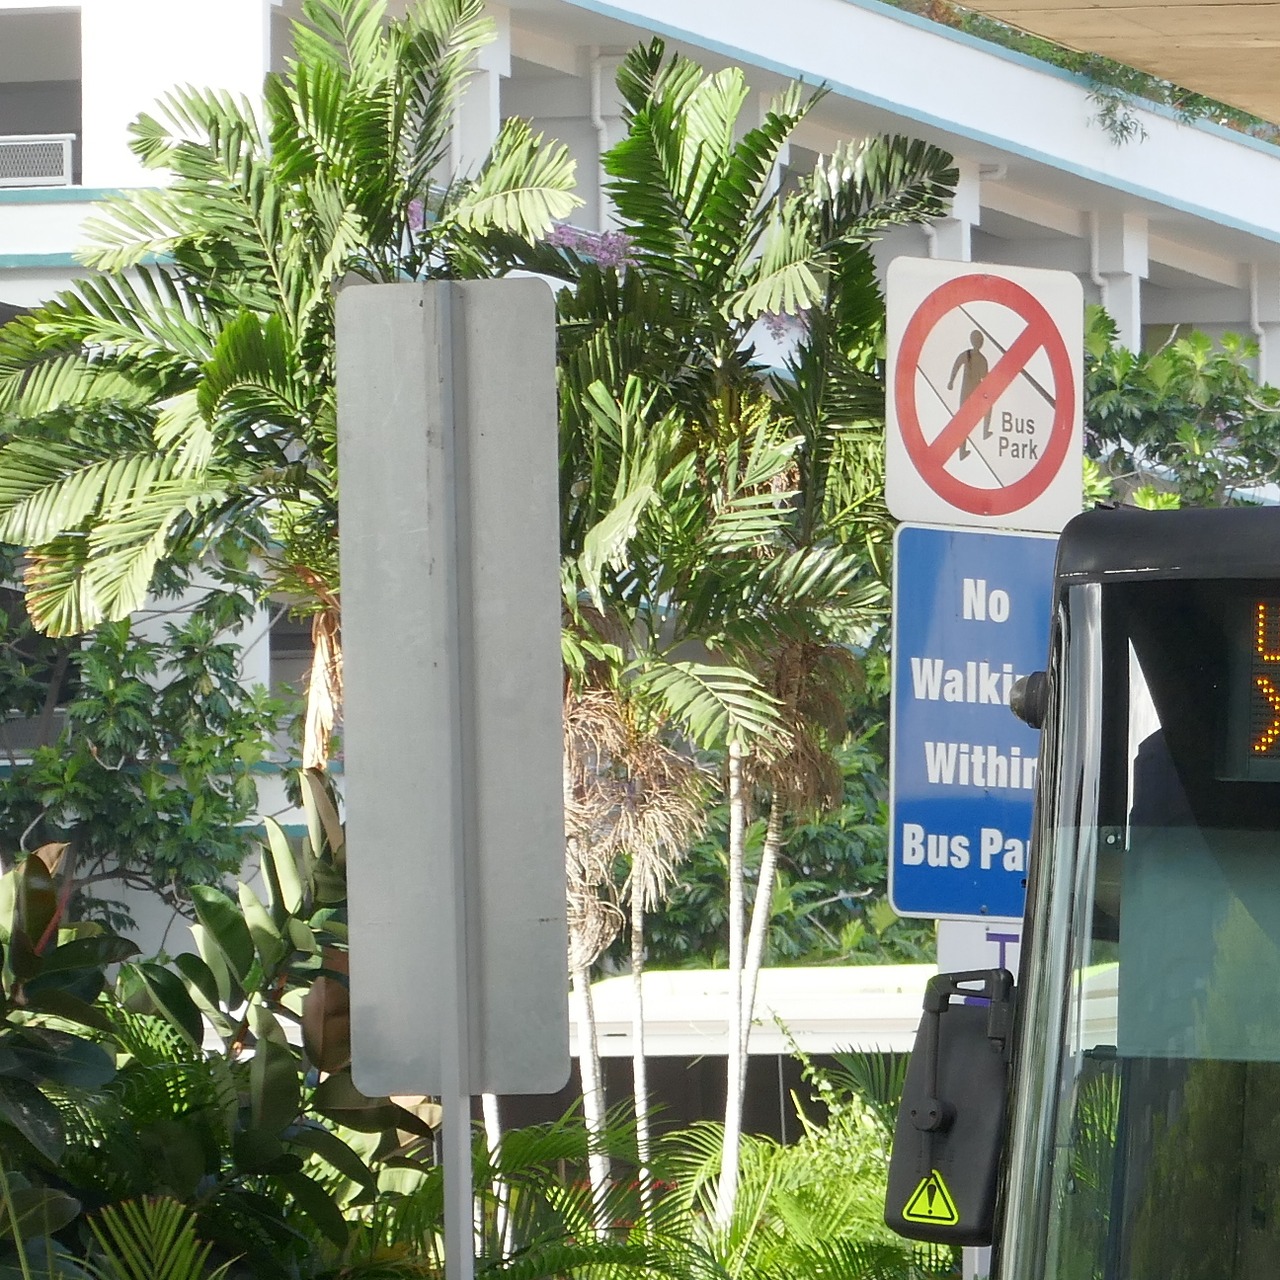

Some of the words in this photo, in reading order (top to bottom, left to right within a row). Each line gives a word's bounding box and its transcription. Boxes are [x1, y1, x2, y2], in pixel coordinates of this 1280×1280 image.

[1001, 411, 1036, 435] Bus
[998, 436, 1039, 462] Park
[962, 578, 1010, 623] No
[910, 656, 1031, 706] Walki
[902, 822, 971, 870] Bus
[980, 827, 1031, 872] Pa
